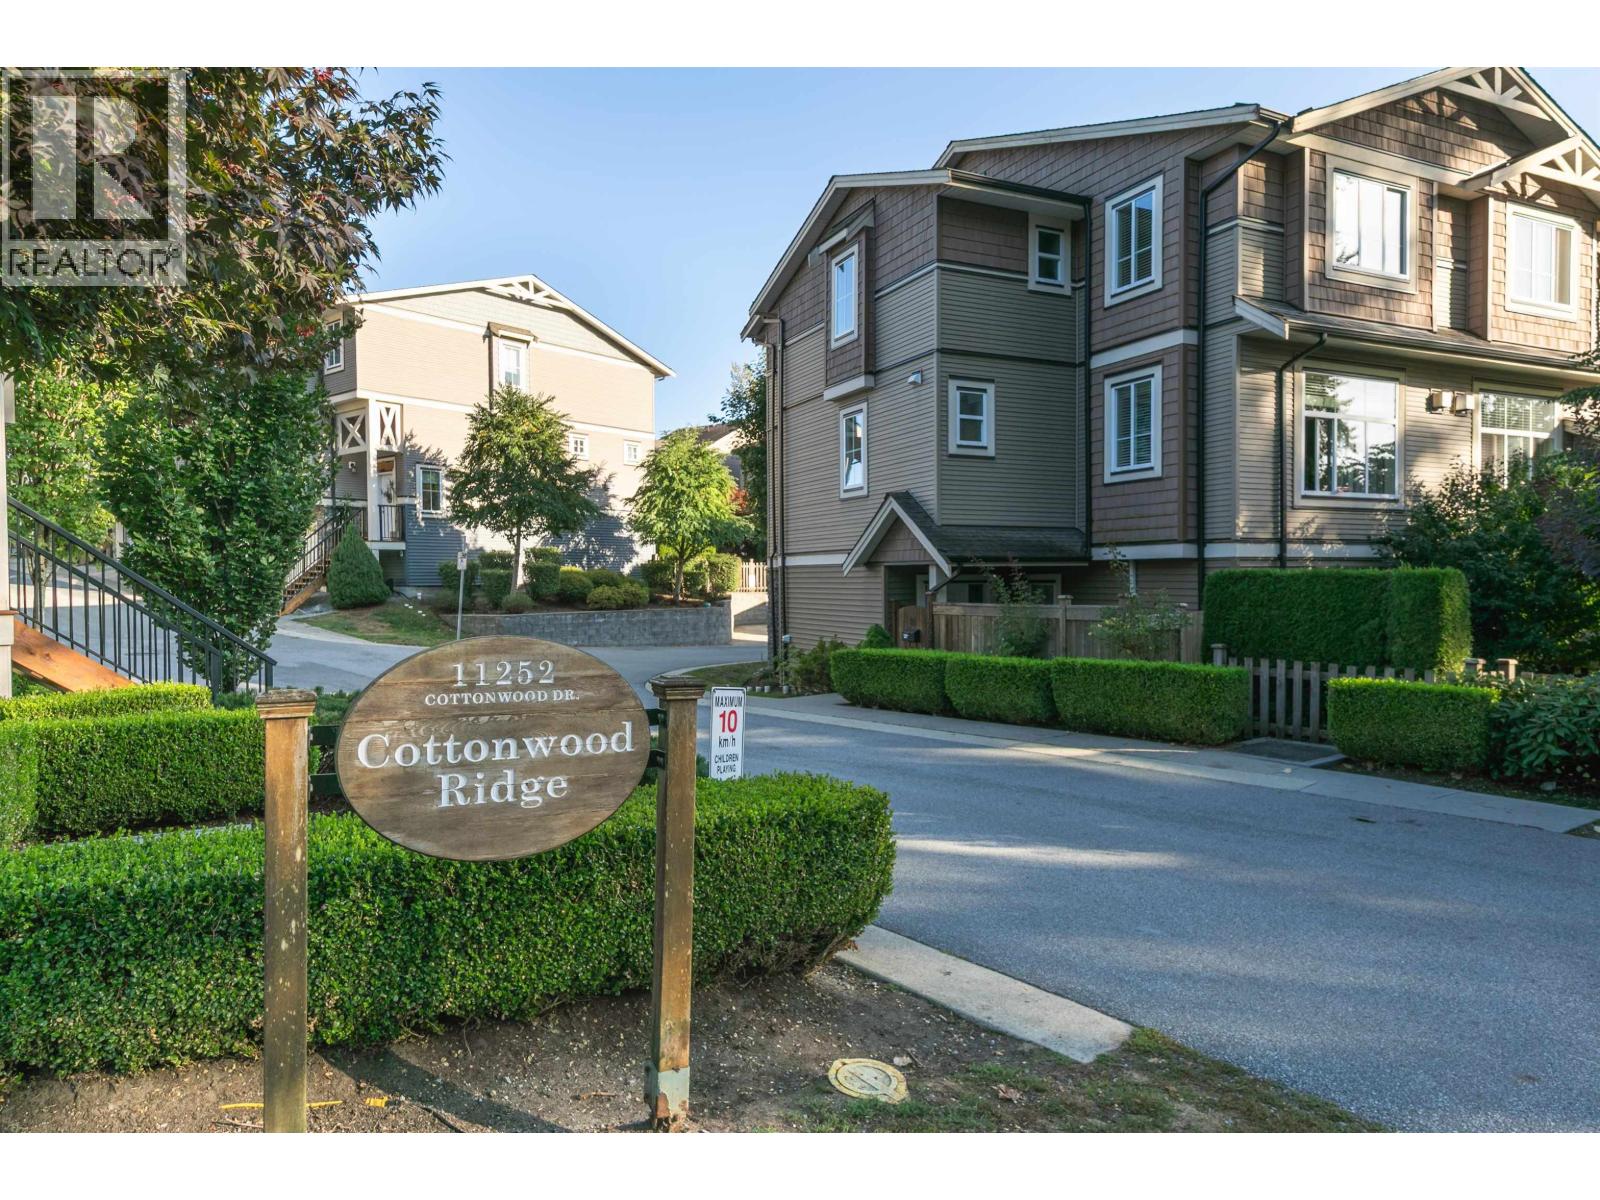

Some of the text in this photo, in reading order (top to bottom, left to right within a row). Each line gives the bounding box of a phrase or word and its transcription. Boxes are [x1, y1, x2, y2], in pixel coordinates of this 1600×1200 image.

[453, 660, 555, 687] 11252
[425, 689, 580, 706] COTTONWOOD DR.
[715, 696, 743, 707] MAXIMUM
[719, 710, 738, 733] 10
[357, 721, 634, 769] Cottonwood
[718, 735, 736, 748] km/h
[714, 753, 739, 764] CHILDREN
[716, 764, 736, 774] PLAYING
[437, 769, 568, 809] Ridge
